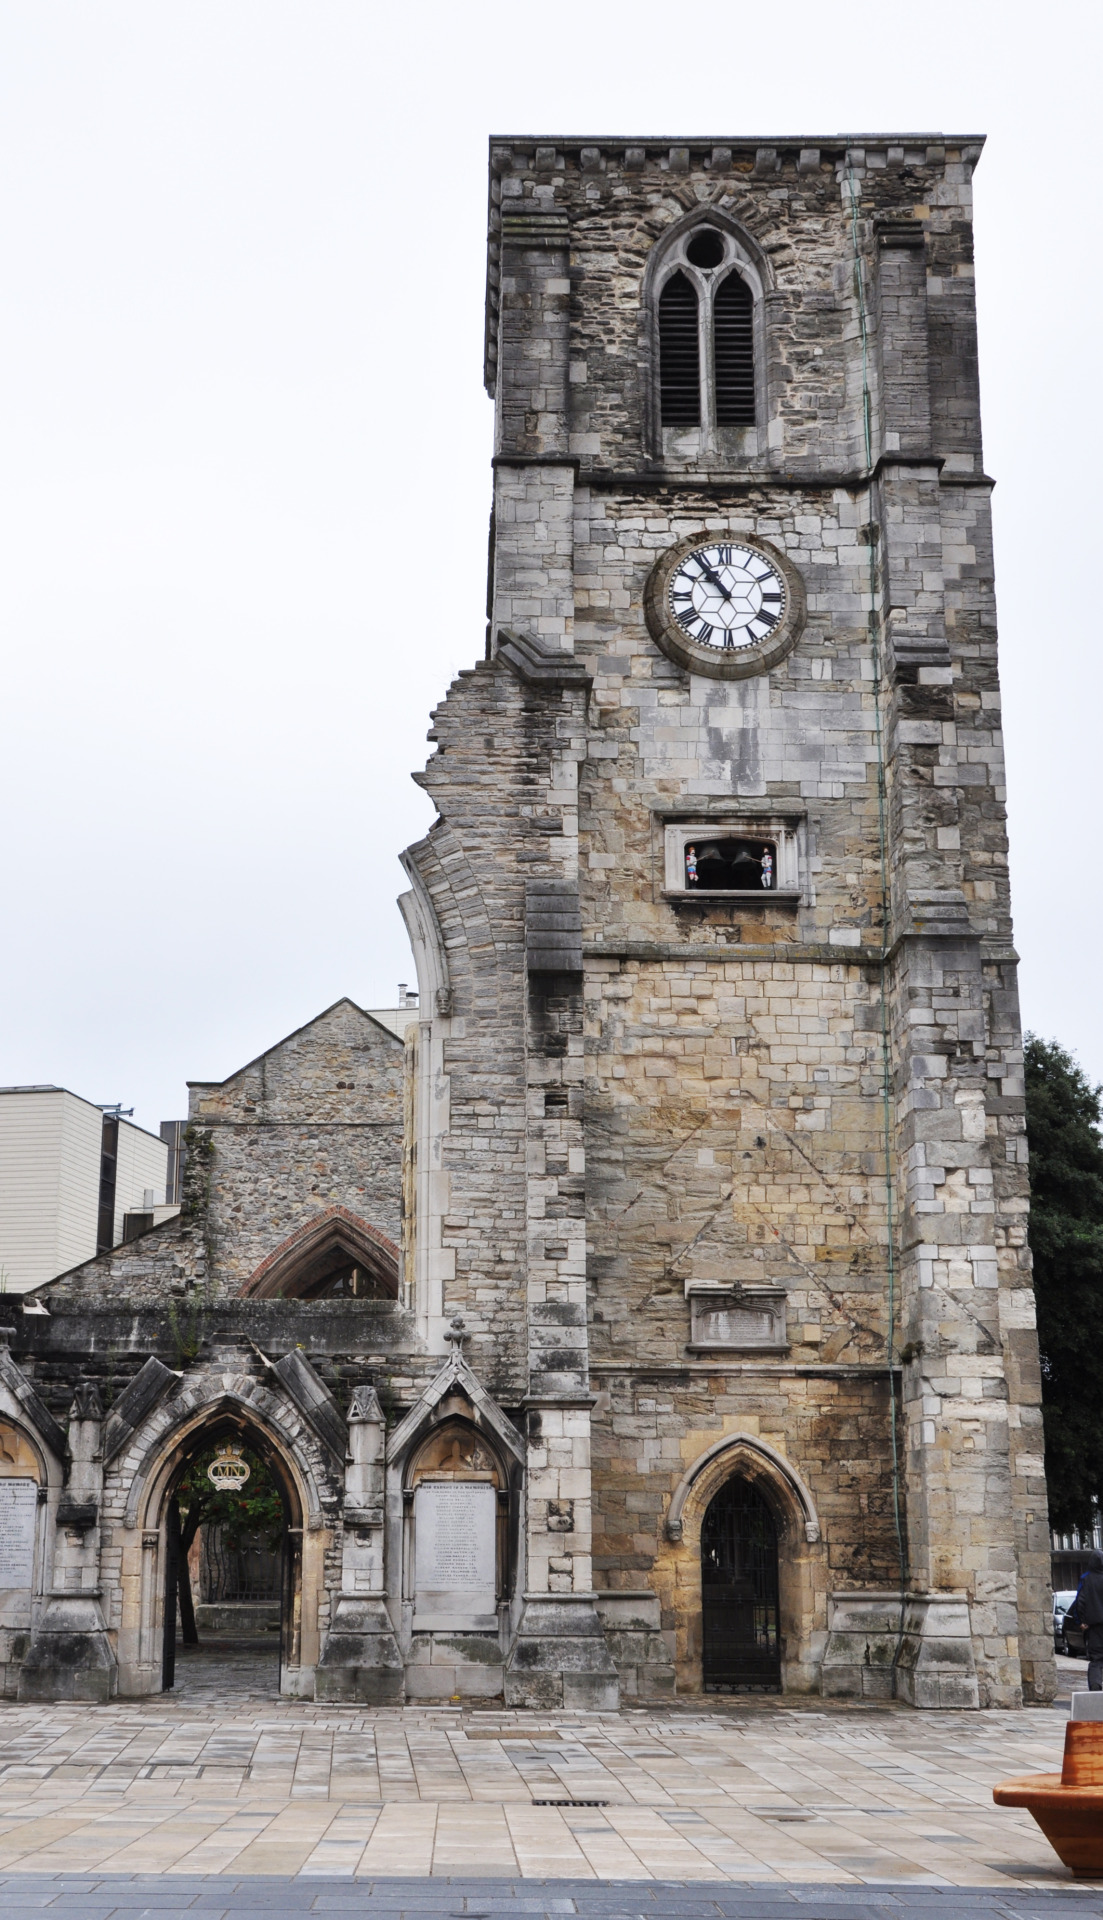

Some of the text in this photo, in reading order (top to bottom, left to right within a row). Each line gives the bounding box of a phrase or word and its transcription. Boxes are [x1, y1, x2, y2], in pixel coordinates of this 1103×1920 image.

[718, 548, 732, 564] XII
[744, 554, 753, 568] I
[756, 571, 774, 582] II
[763, 593, 781, 602] III
[218, 1464, 240, 1477] MN
